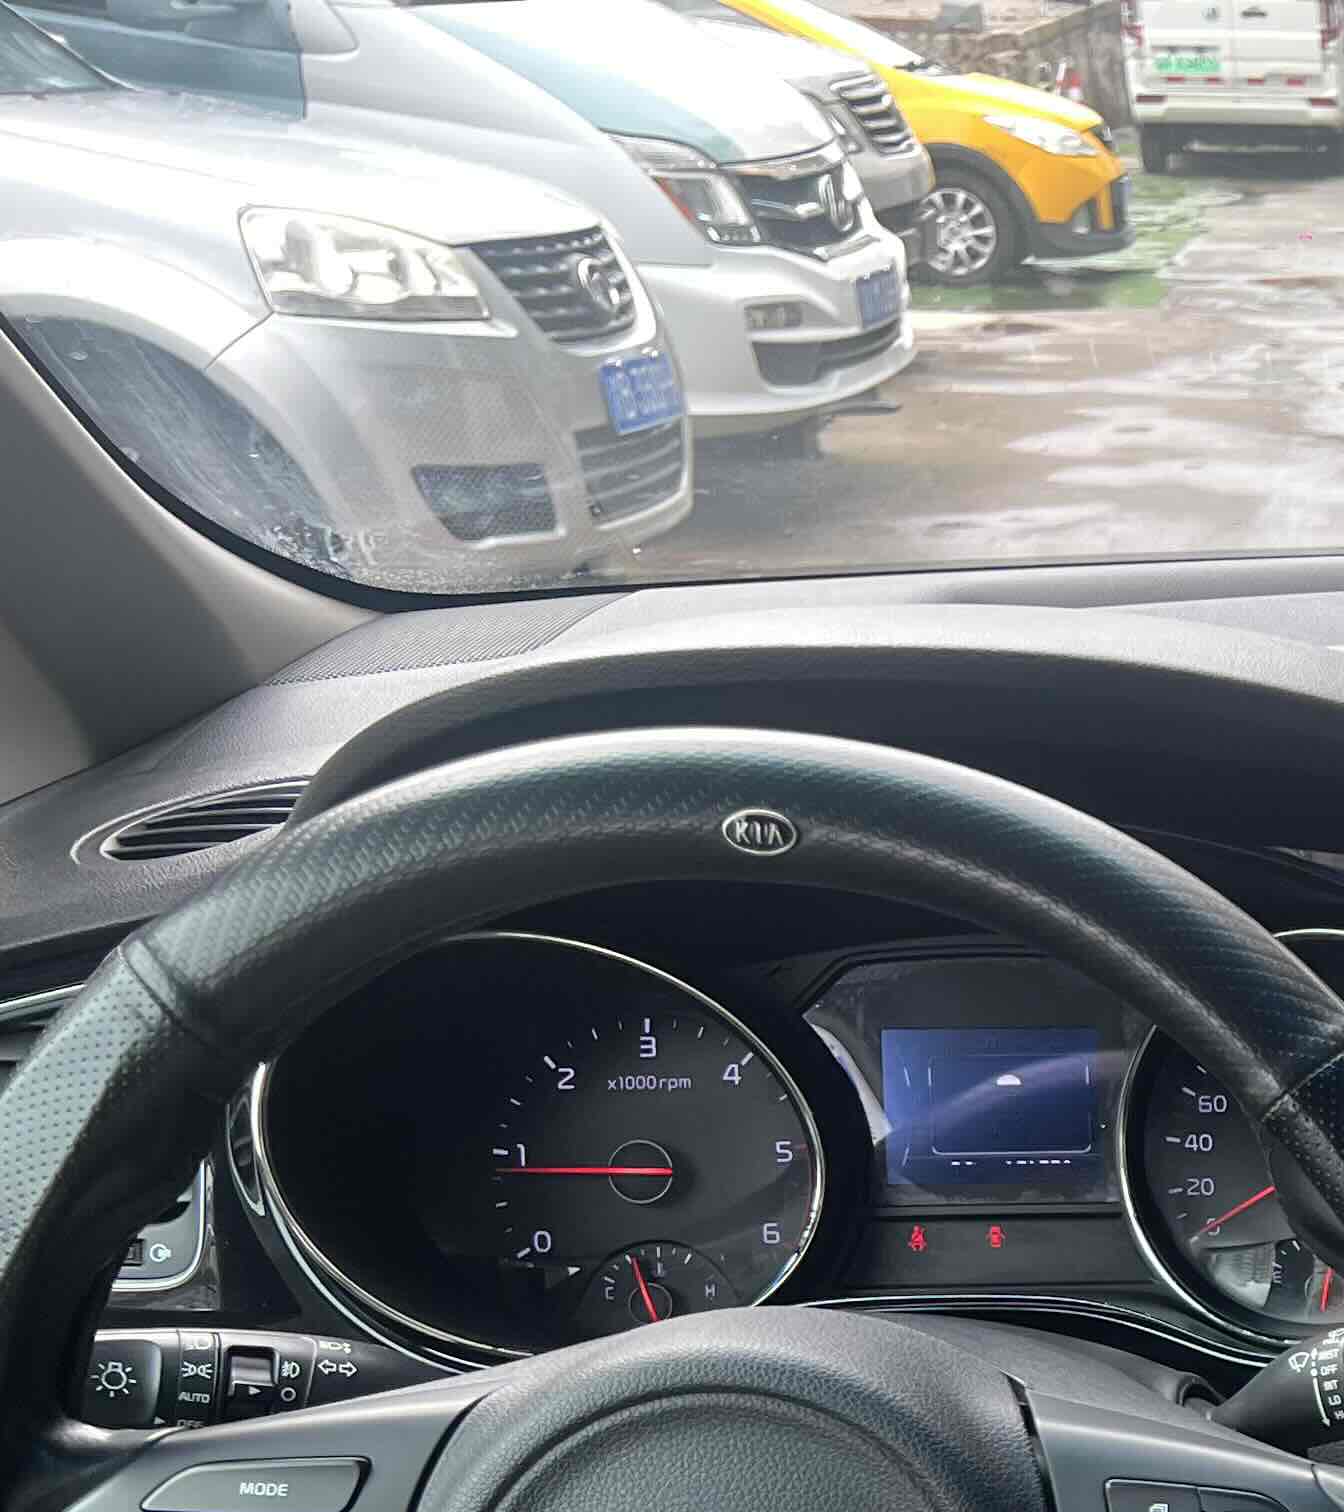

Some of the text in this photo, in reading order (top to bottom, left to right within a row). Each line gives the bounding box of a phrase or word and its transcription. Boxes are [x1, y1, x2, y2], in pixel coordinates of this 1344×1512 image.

[735, 818, 785, 846] KIA
[639, 1035, 657, 1058] 3
[557, 1067, 576, 1090] 2
[659, 1077, 692, 1093] rpm
[722, 1063, 742, 1085] 4
[1198, 1095, 1228, 1113] 60
[775, 1140, 793, 1163] 5
[1184, 1133, 1213, 1152] 40
[516, 1143, 527, 1167] 1
[1186, 1178, 1215, 1196] 20
[533, 1230, 551, 1252] 0
[762, 1222, 780, 1244] 6
[178, 1391, 210, 1404] AUTO
[240, 1482, 289, 1497] MODE
